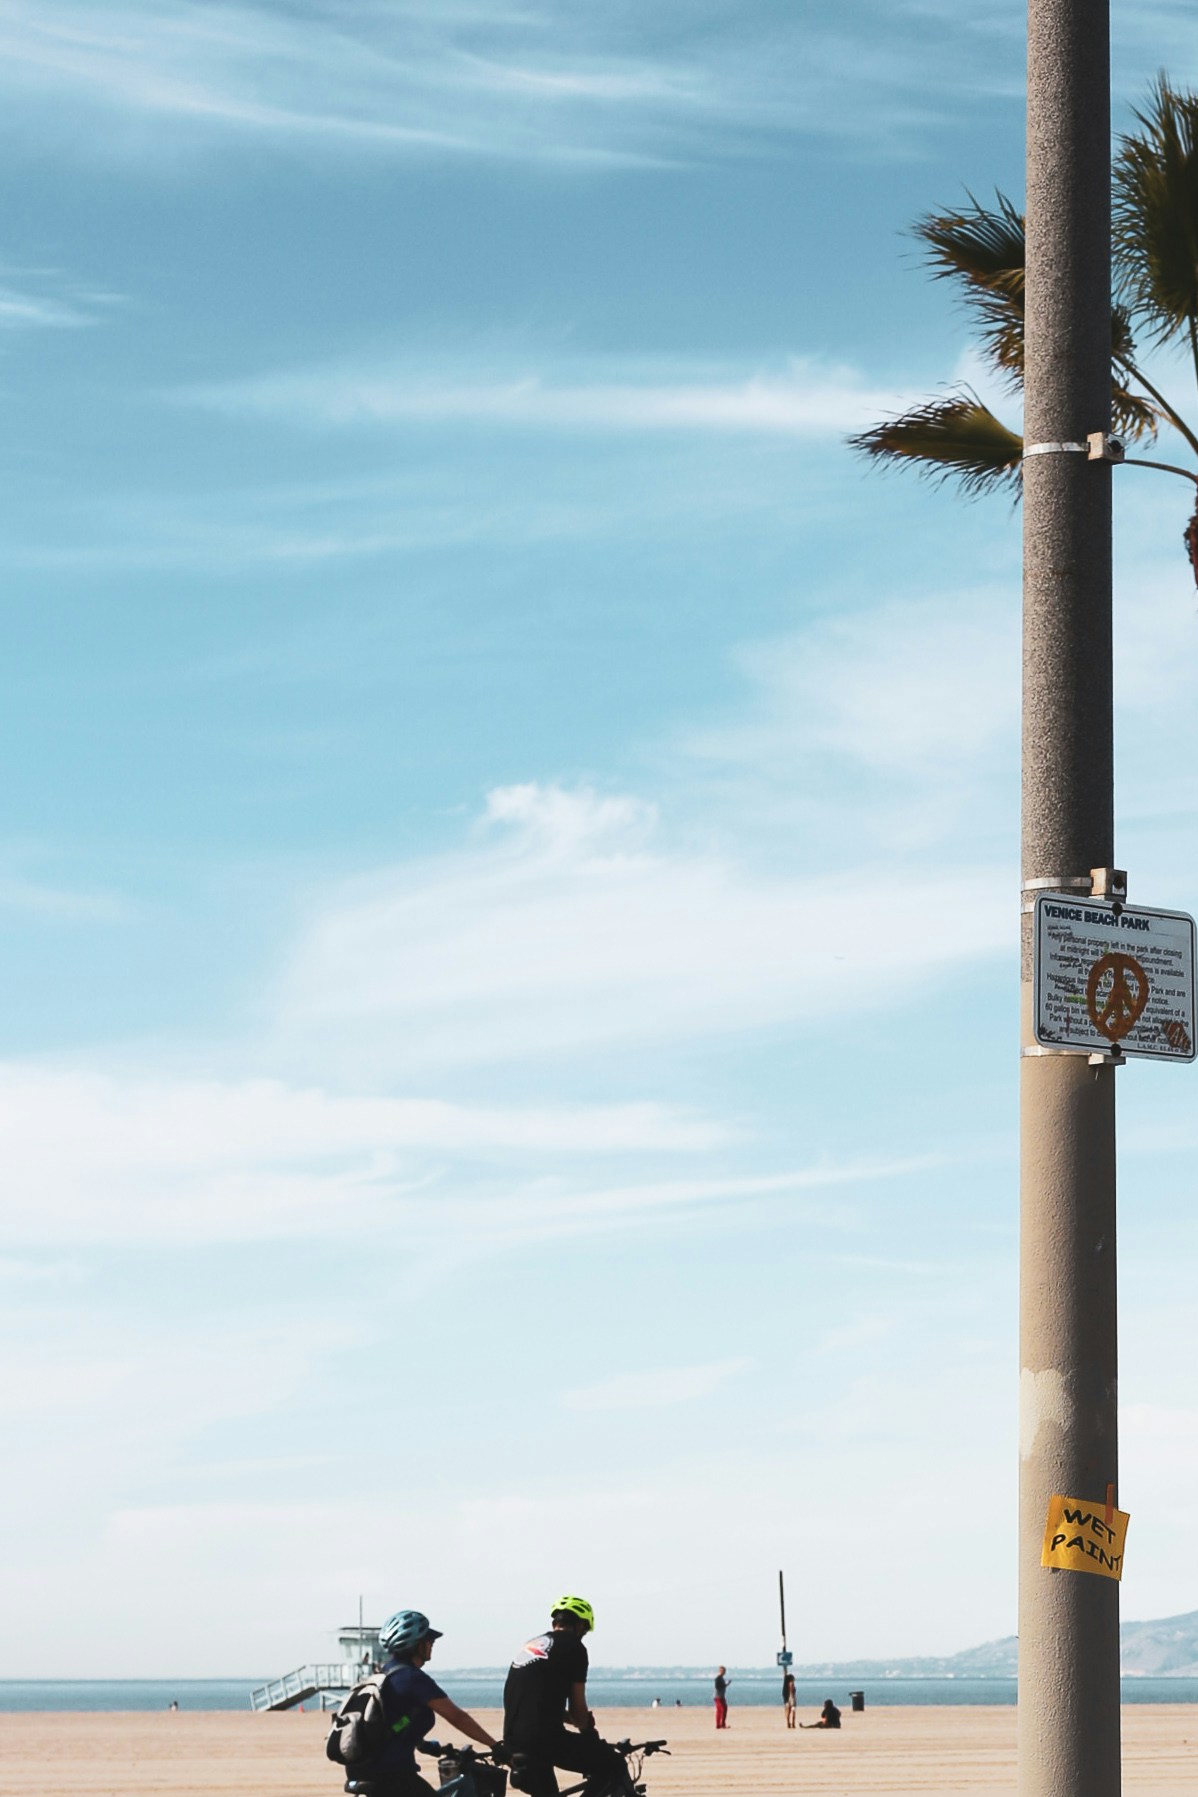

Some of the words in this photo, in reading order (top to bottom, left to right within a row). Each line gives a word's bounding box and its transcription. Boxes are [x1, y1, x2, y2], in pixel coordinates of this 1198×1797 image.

[1044, 905, 1082, 921] VENICE
[1084, 911, 1118, 927] BEACH
[1121, 917, 1150, 931] PARK
[1152, 986, 1164, 994] Park
[1063, 1508, 1116, 1544] WET
[1050, 1533, 1122, 1572] PAINT
